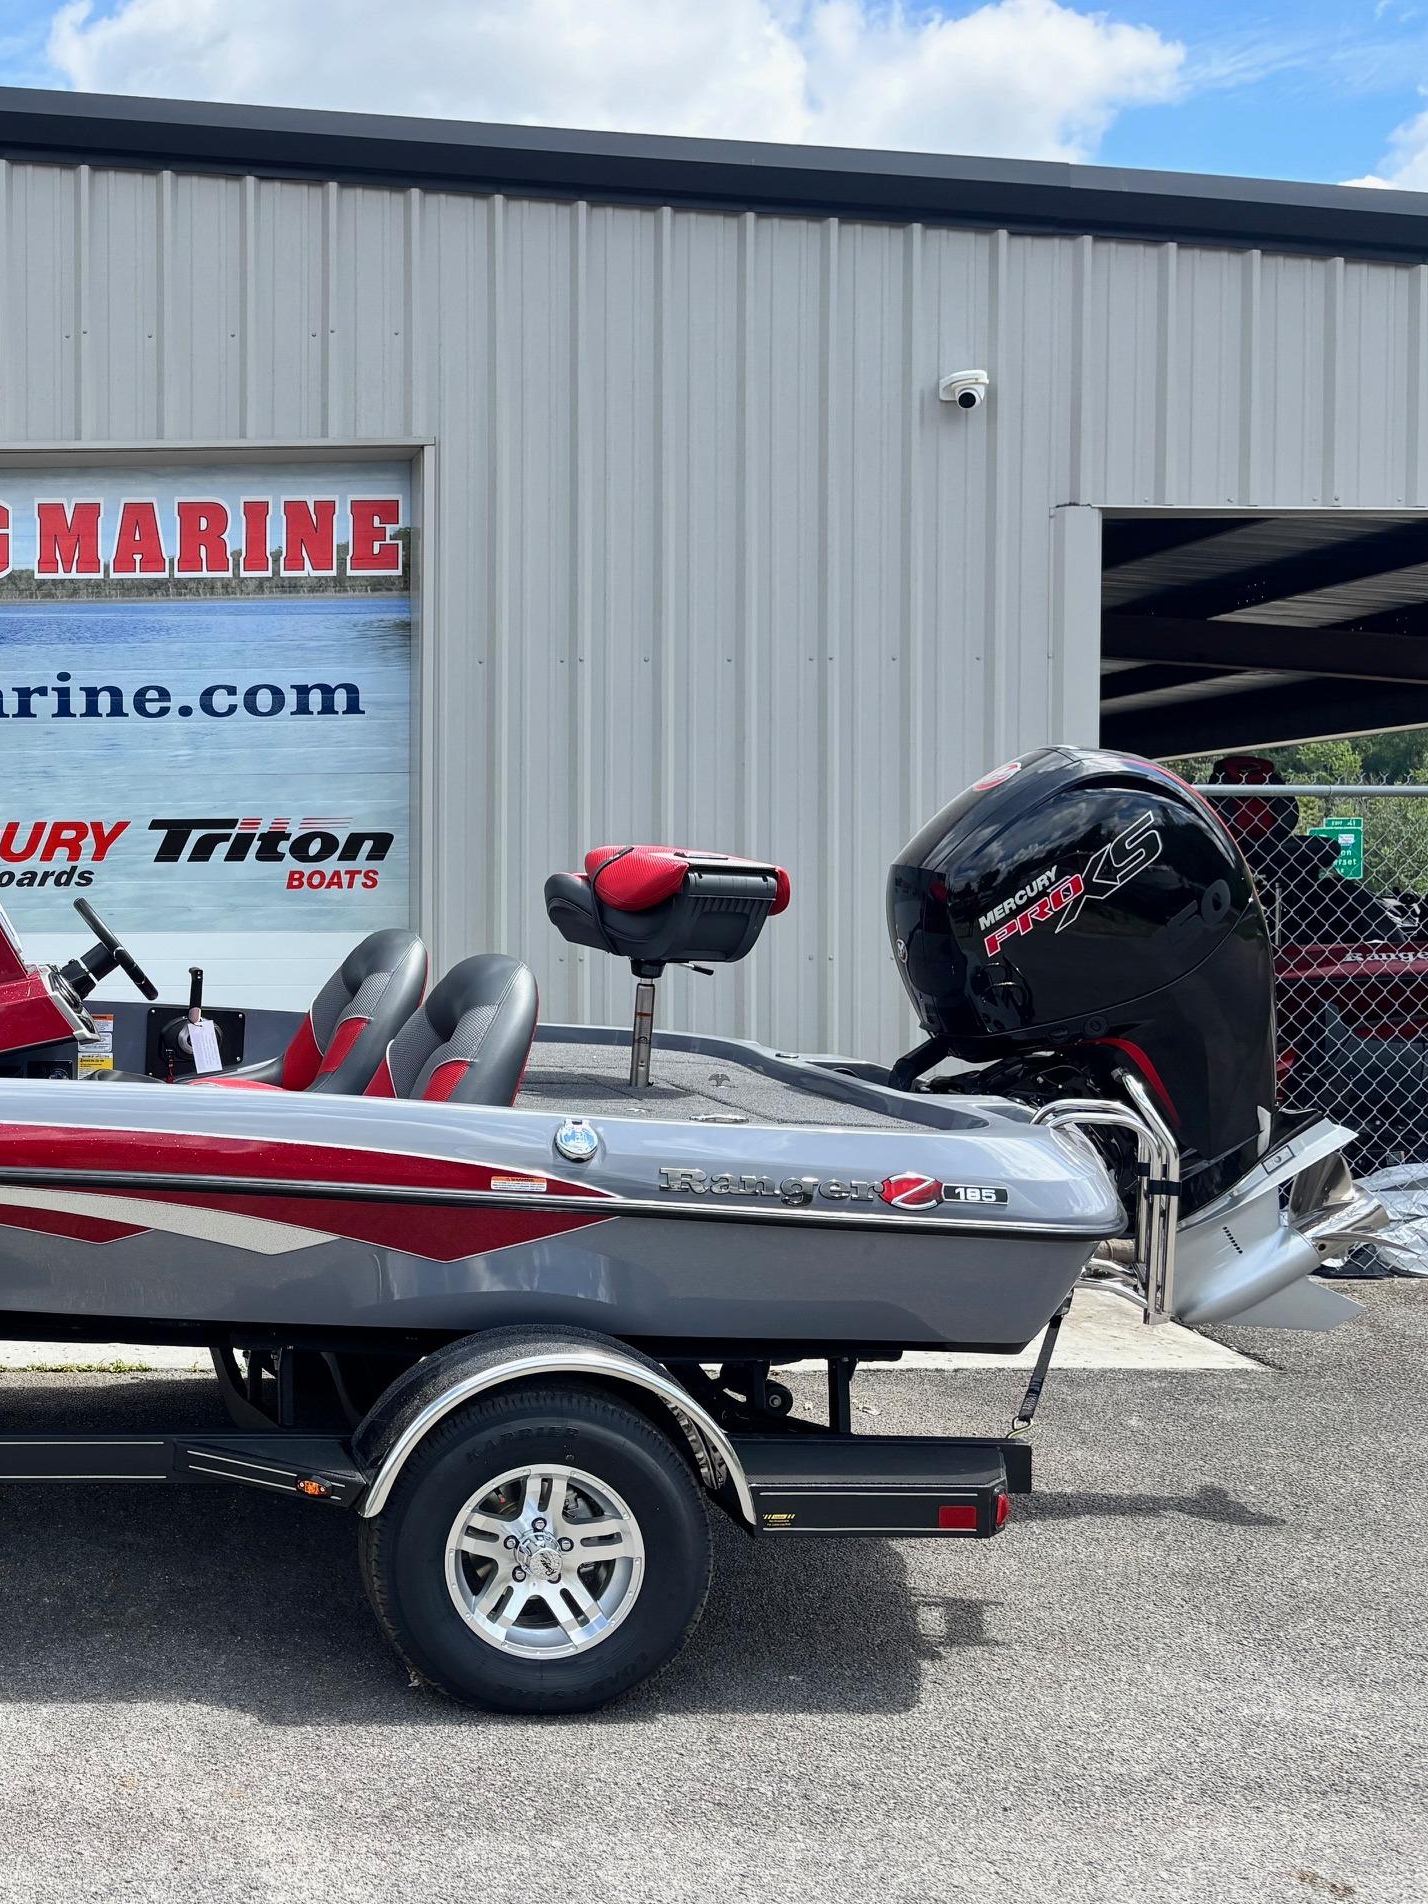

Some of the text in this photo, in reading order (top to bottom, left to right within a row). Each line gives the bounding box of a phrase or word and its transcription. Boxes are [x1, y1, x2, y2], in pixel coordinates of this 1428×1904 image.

[34, 495, 403, 579] MARINE
[148, 817, 395, 863] Triton
[286, 869, 379, 889] BOATS
[978, 865, 1058, 931] MERCURY
[1340, 951, 1428, 964] Range
[658, 1167, 885, 1207] Ranger
[954, 1186, 997, 1203] 185
